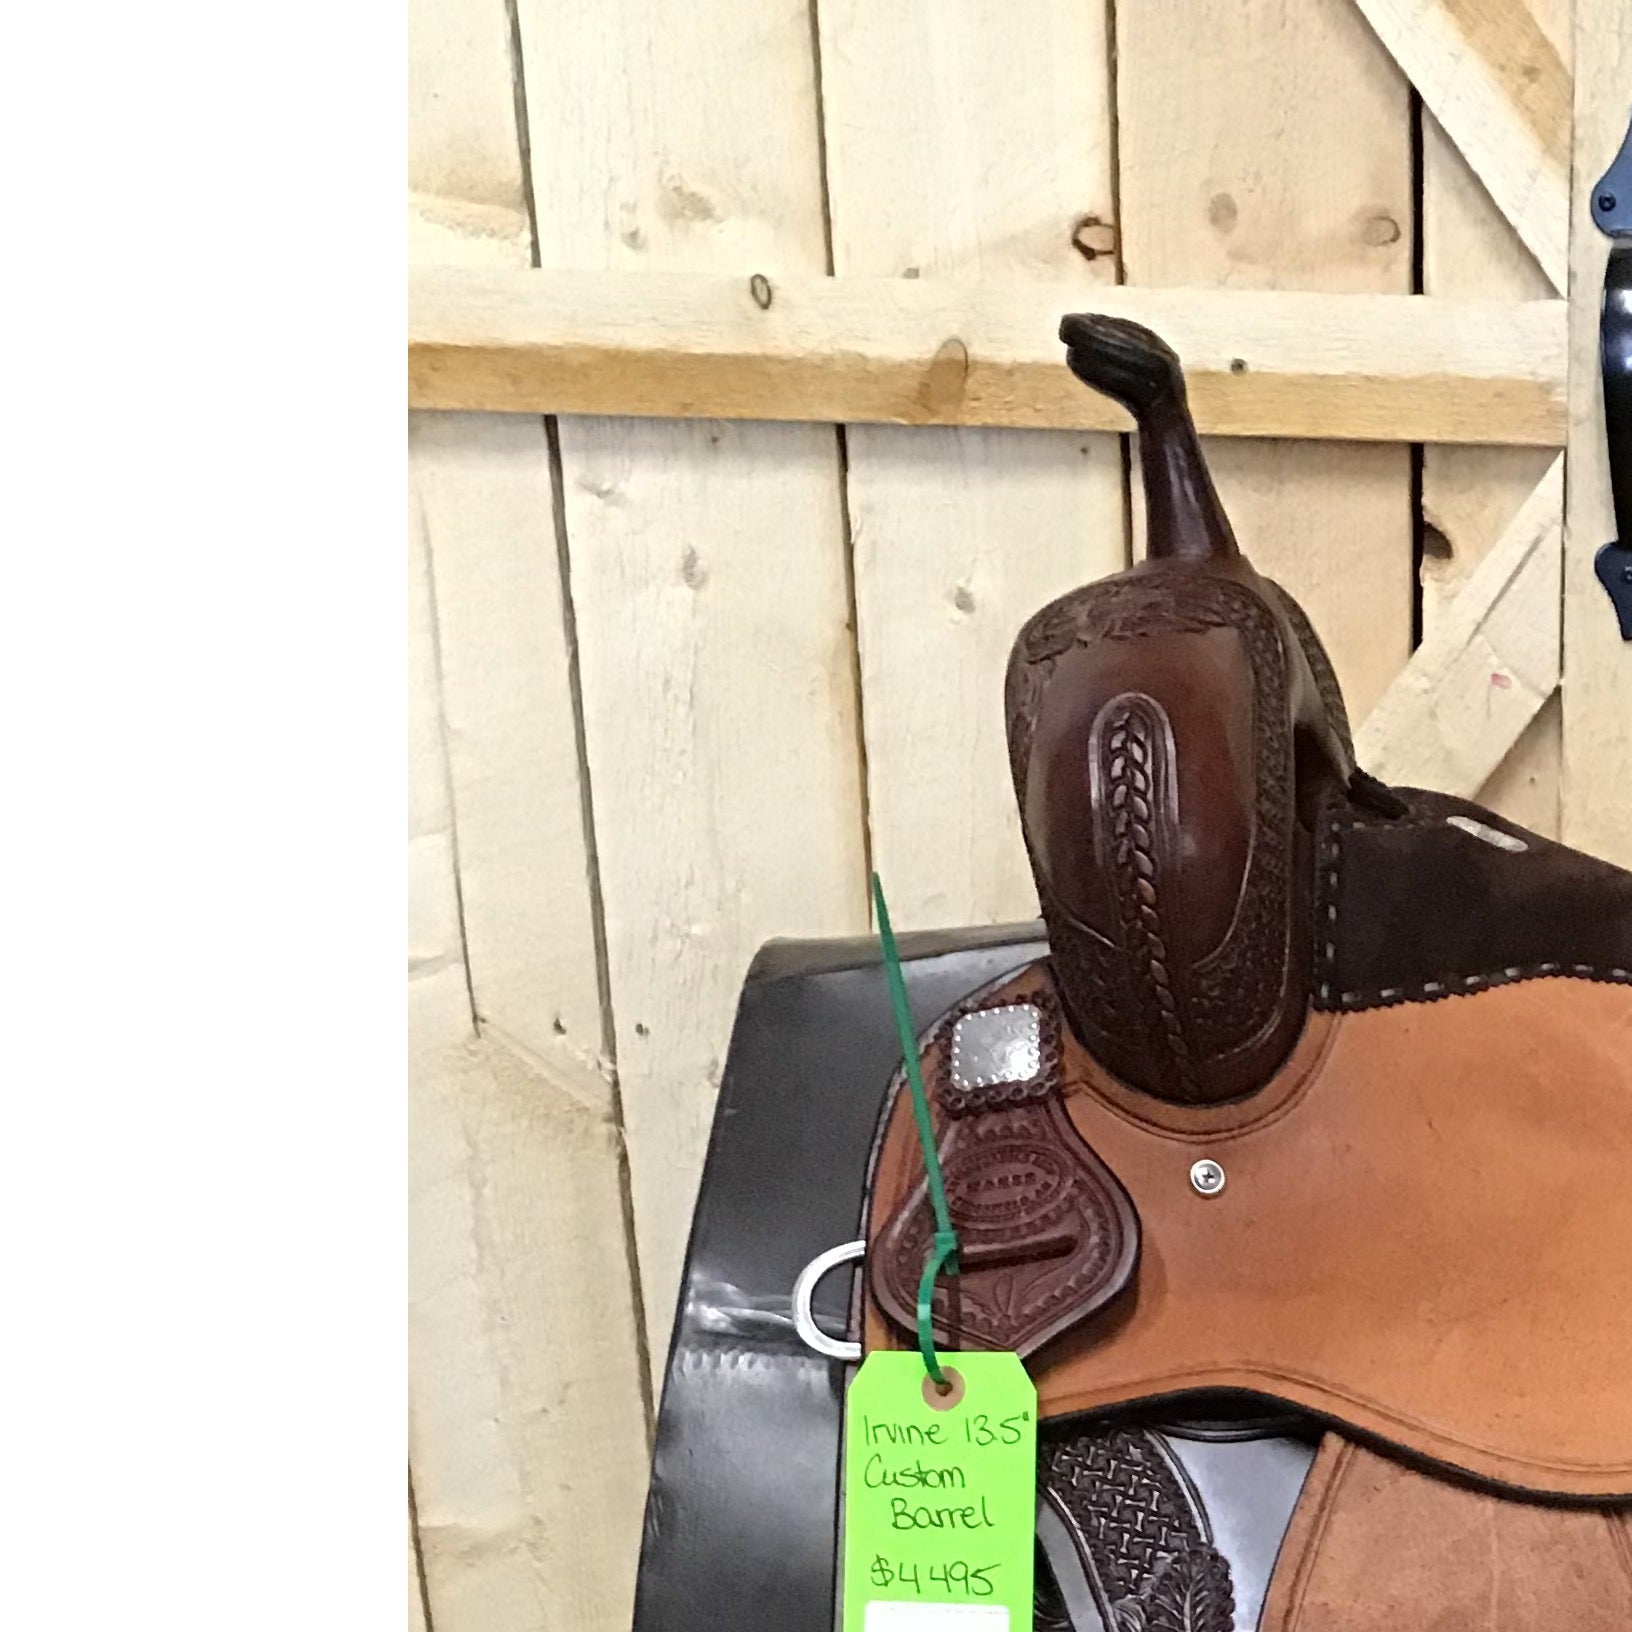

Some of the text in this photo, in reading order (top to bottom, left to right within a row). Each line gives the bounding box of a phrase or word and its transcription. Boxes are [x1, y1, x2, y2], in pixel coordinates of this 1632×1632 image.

[864, 1414, 949, 1446] Irvine
[864, 1453, 966, 1489] Custom
[890, 1495, 995, 1530] Barrel
